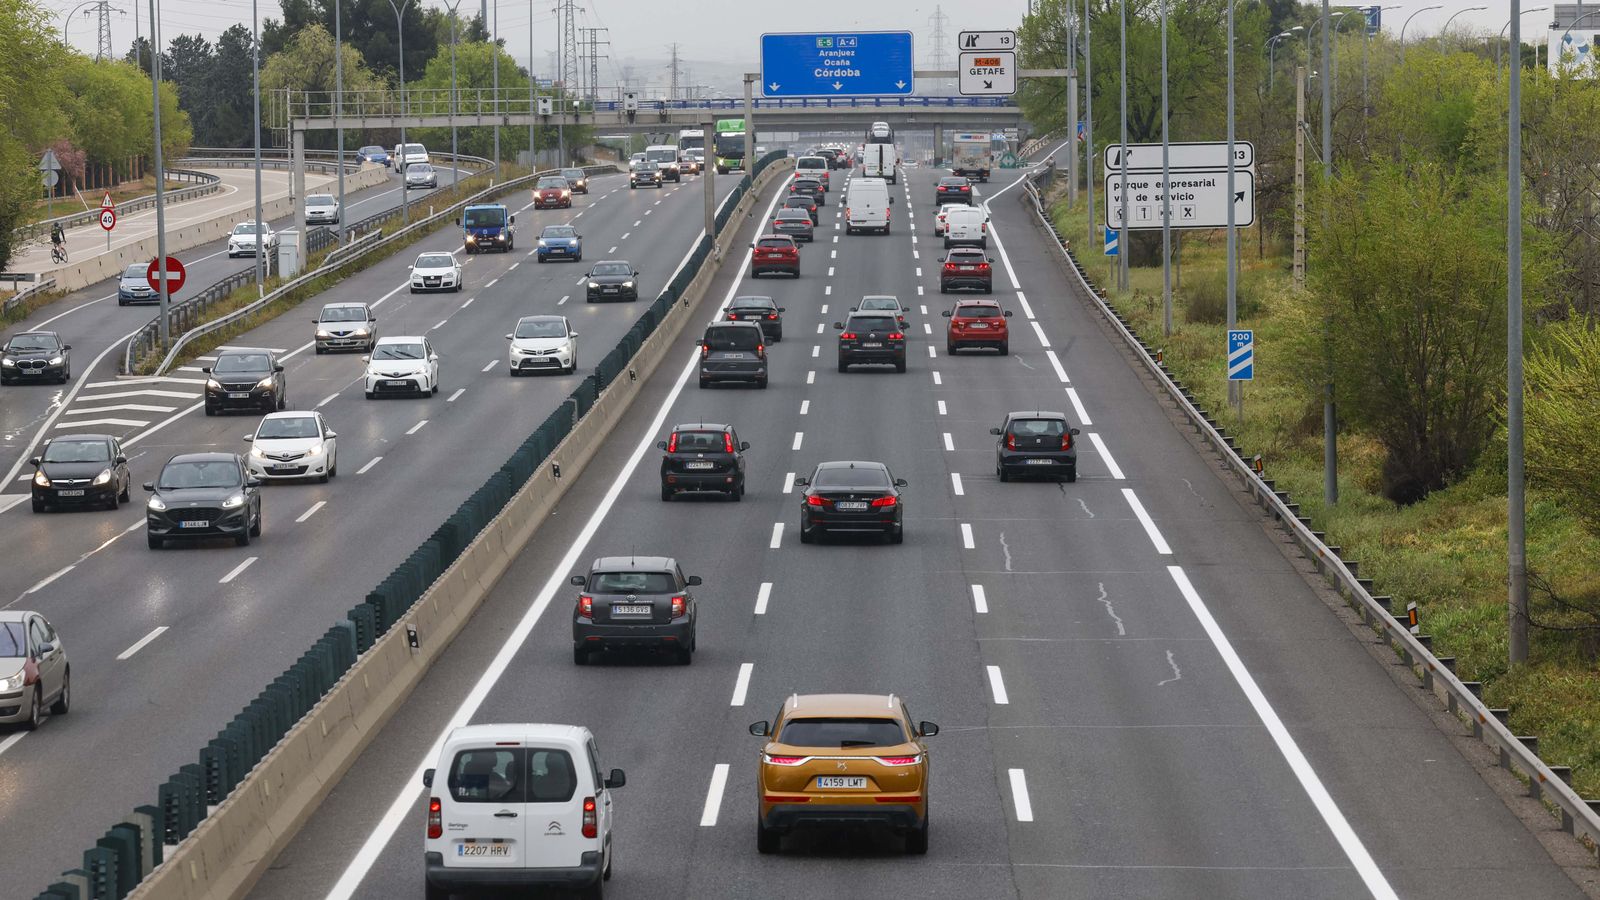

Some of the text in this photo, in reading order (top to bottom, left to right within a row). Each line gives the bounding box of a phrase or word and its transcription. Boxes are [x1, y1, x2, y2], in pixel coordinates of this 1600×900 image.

[1000, 36, 1010, 44] 13
[814, 68, 861, 77] Córdoba
[1234, 150, 1245, 159] 13
[1113, 182, 1149, 191] prque
[1135, 193, 1148, 201] de
[1231, 333, 1250, 341] 200
[823, 779, 843, 787] 4159
[464, 846, 508, 855] 2207 HRV
